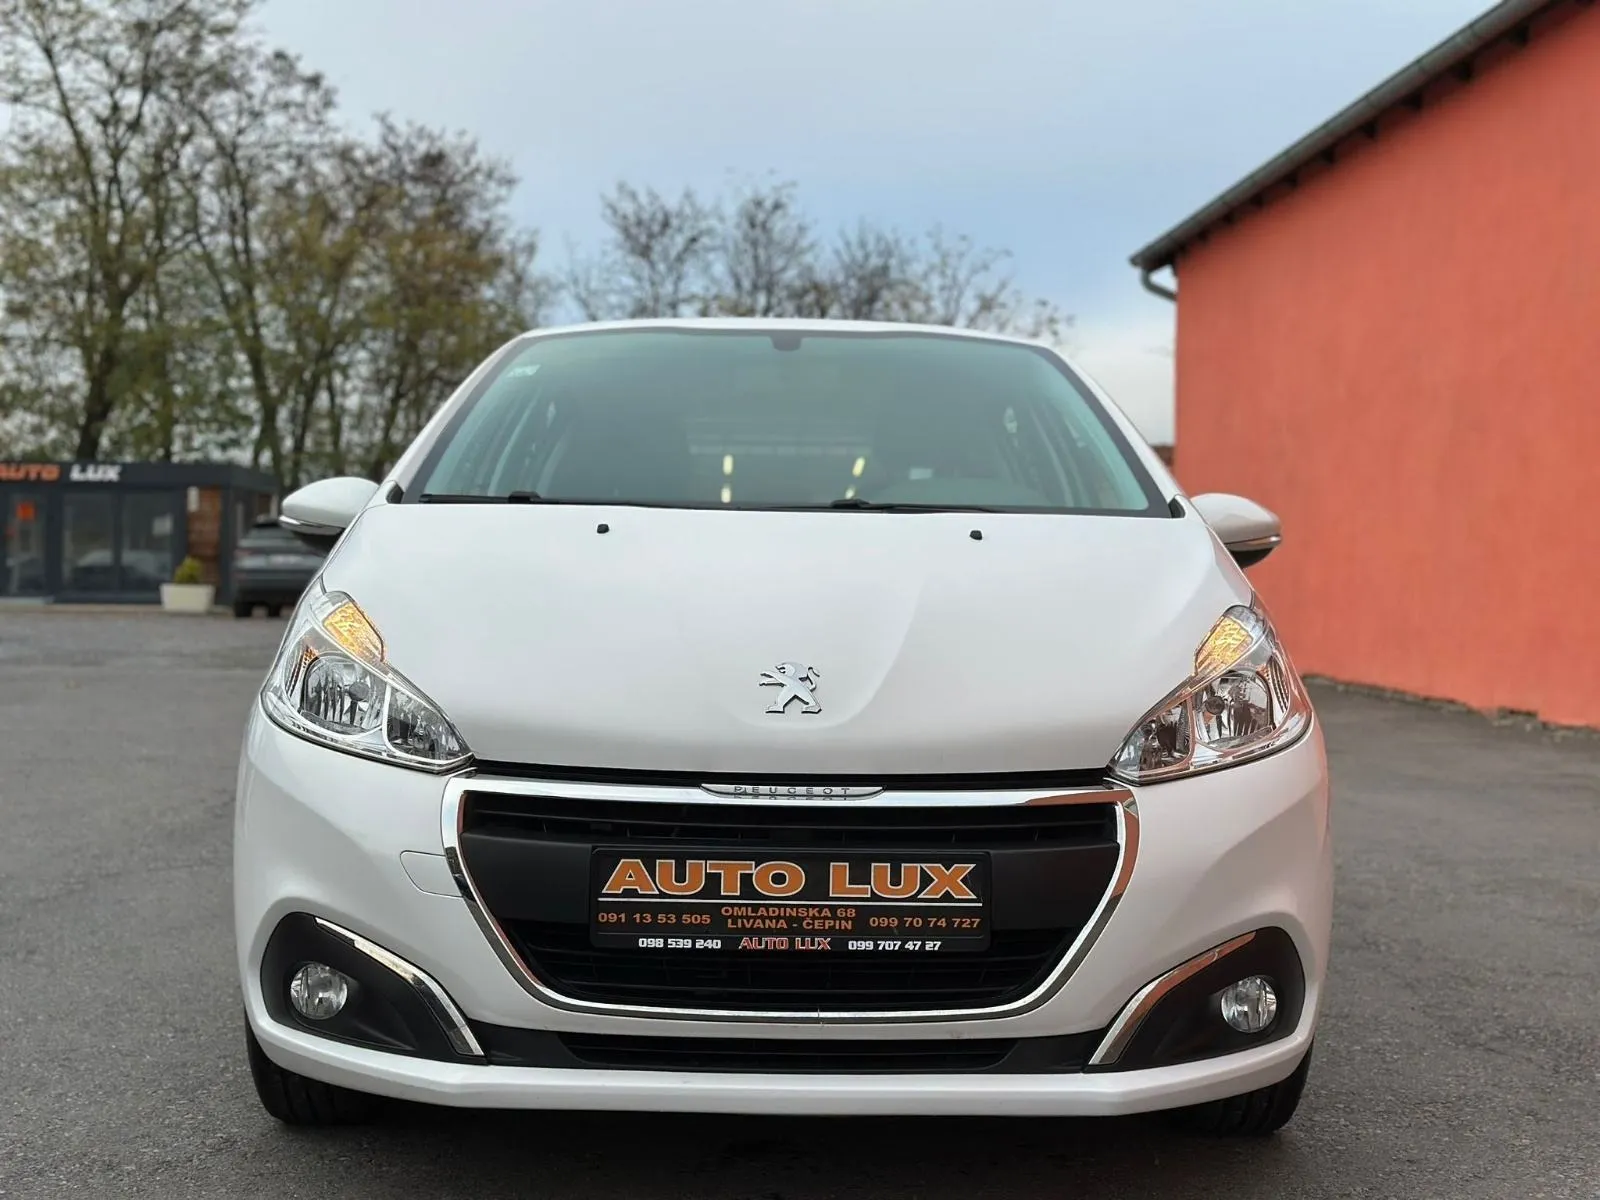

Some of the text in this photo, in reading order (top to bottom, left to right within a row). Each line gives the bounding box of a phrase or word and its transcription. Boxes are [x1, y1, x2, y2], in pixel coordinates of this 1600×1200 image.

[70, 464, 121, 481] LUX
[734, 785, 850, 795] PEUGEOT
[602, 858, 978, 899] AUTO LUX
[721, 906, 856, 918] OMLADINSKA 68
[598, 912, 711, 925] 091 13 53 505
[727, 919, 788, 929] LIVANA
[802, 917, 853, 930] ČEPIN
[869, 917, 981, 928] 099 70 74 727
[638, 938, 721, 949] 098 539 240
[738, 937, 832, 950] AUTO LUX
[848, 940, 942, 951] 099 707 47 27
